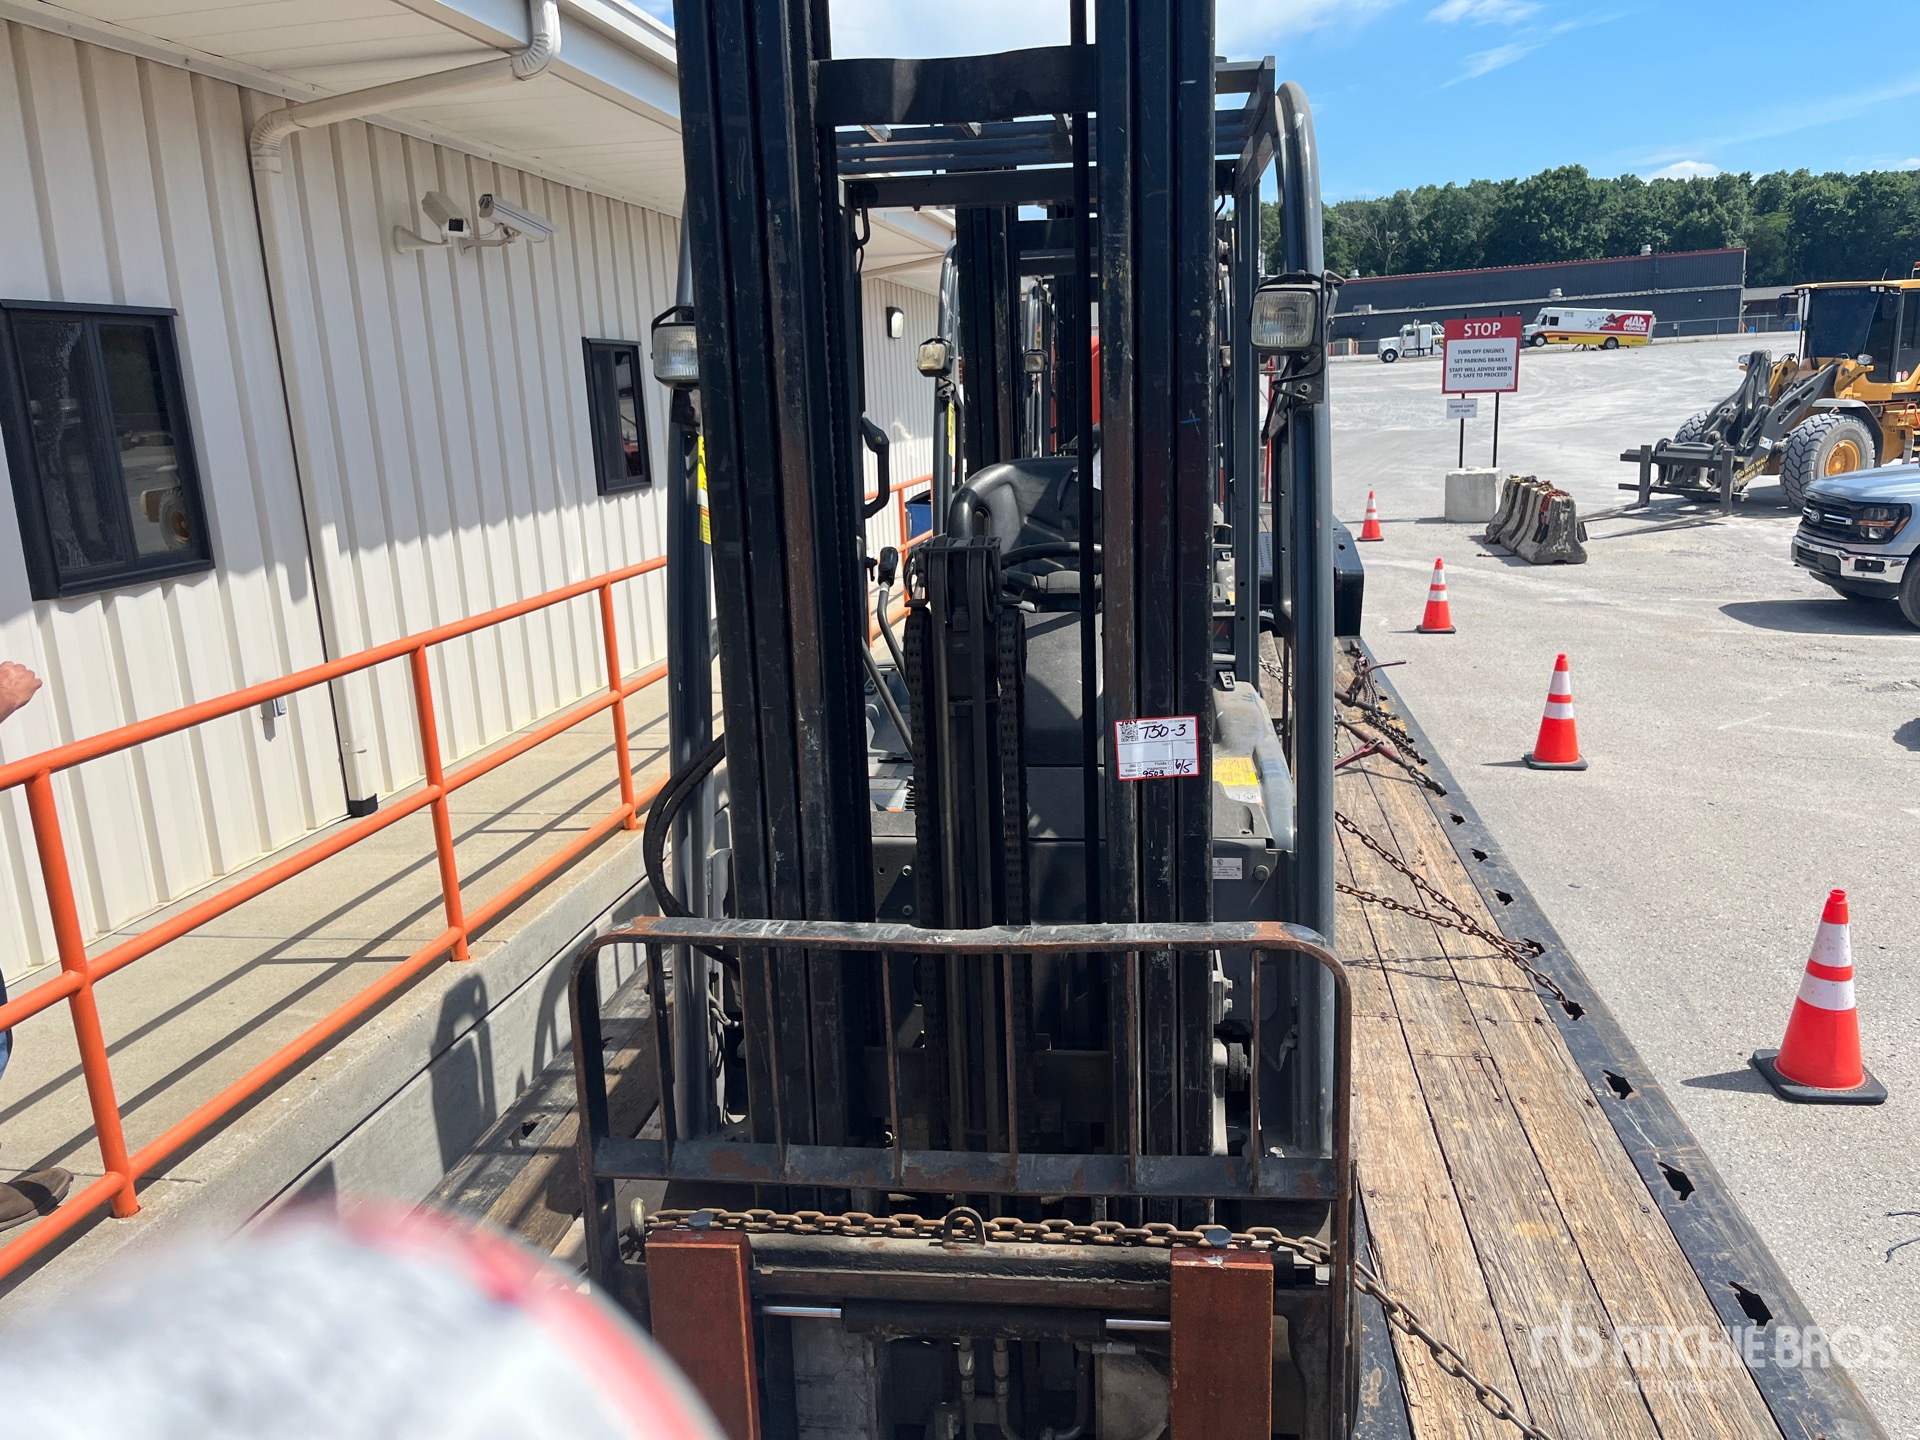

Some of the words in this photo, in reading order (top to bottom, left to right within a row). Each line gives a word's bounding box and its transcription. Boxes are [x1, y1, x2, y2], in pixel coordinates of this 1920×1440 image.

[1623, 316, 1647, 327] MAC
[1464, 322, 1501, 337] STOP
[1736, 470, 1745, 478] DO
[1744, 463, 1755, 473] NOT
[1142, 770, 1165, 778] 9503
